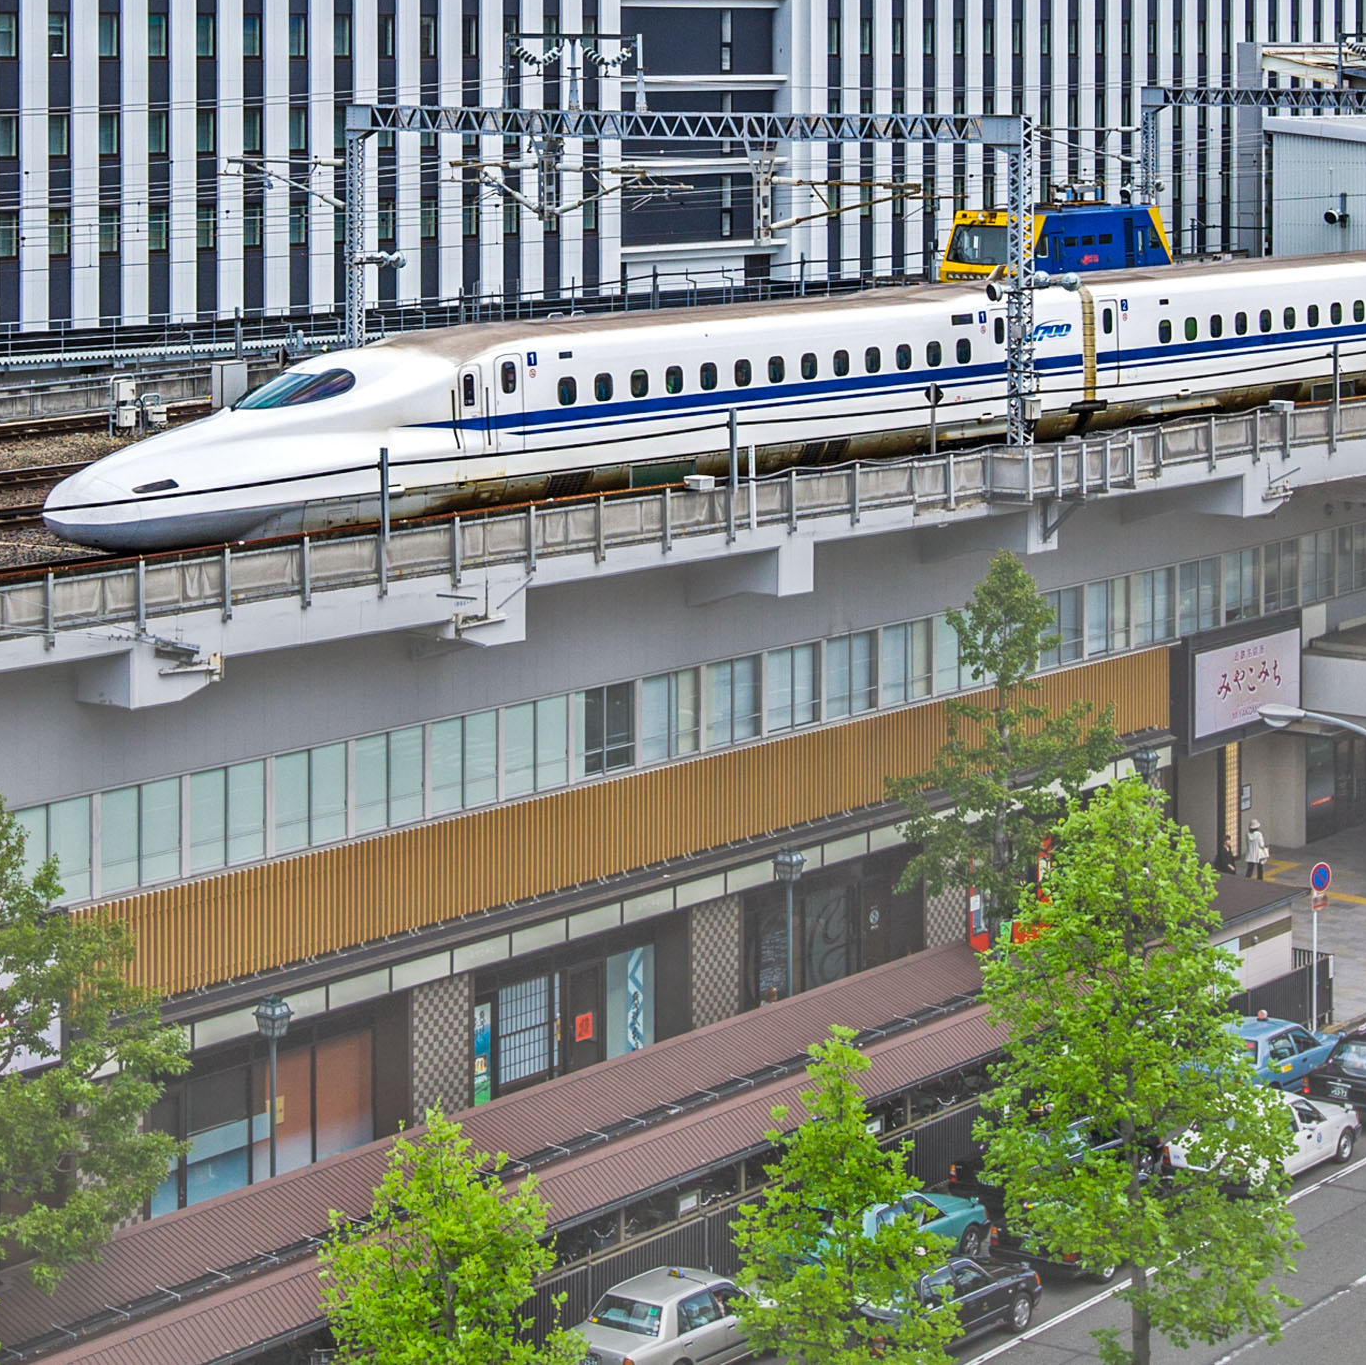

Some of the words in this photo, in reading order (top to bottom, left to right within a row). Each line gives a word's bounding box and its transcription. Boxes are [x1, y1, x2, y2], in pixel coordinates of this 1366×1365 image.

[1025, 323, 1072, 341] 700
[1217, 659, 1282, 700] みやこみち
